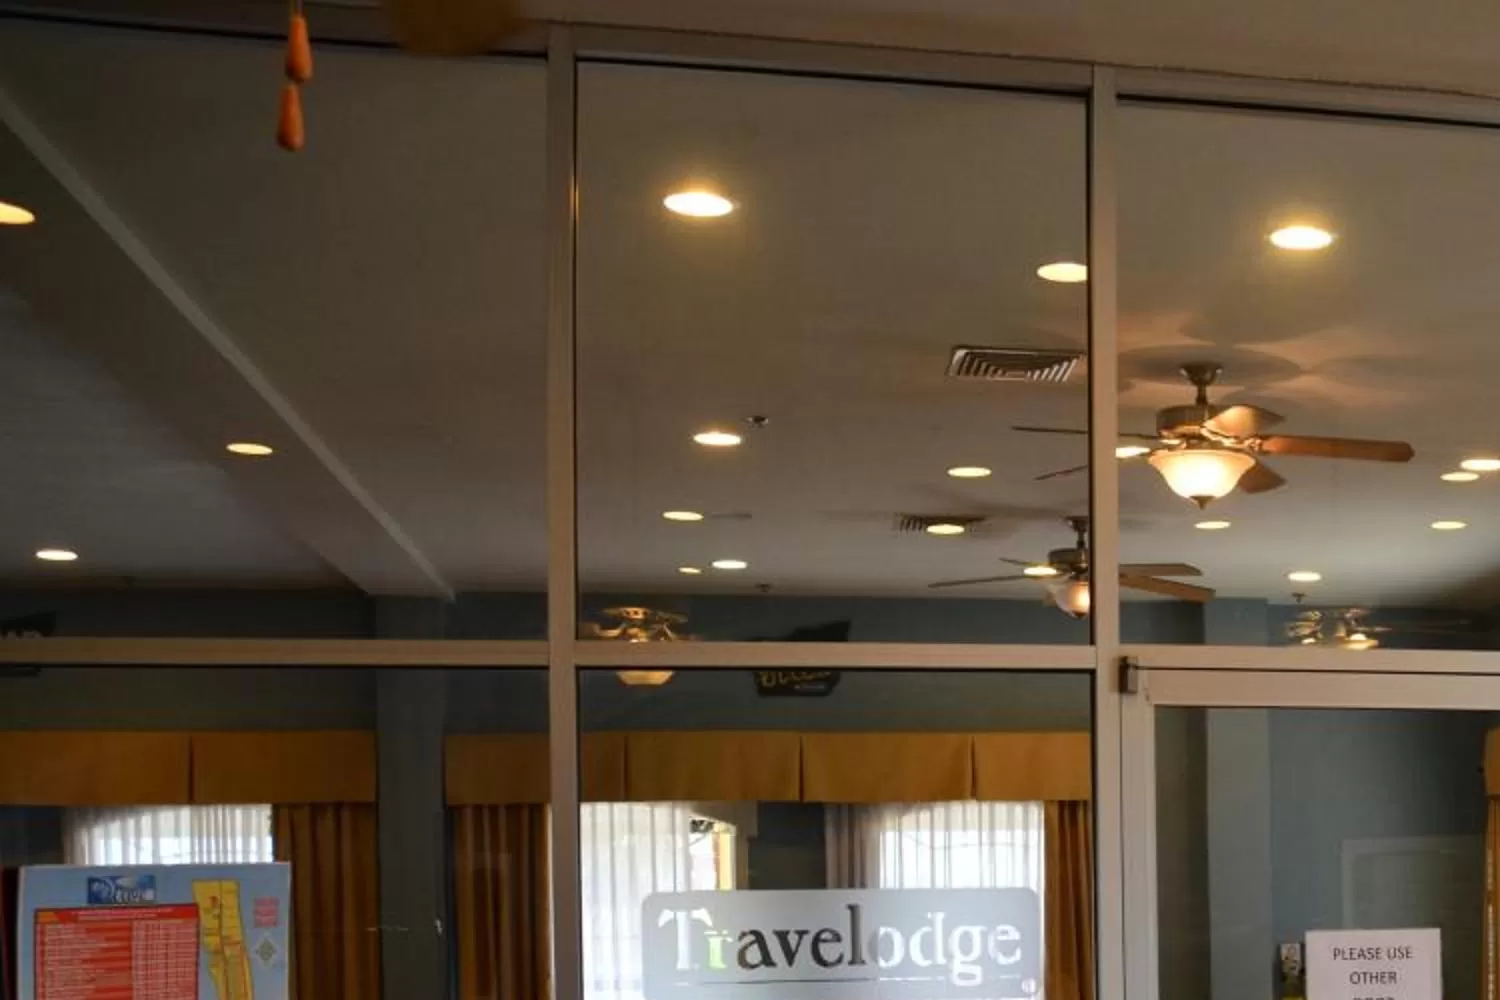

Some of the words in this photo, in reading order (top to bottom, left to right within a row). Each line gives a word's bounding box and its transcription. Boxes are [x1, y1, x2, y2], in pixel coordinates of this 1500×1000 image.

[657, 904, 1022, 987] Travelodge
[1332, 947, 1383, 960] PLEASE
[1387, 946, 1413, 959] USE
[1349, 971, 1398, 985] OTHER
